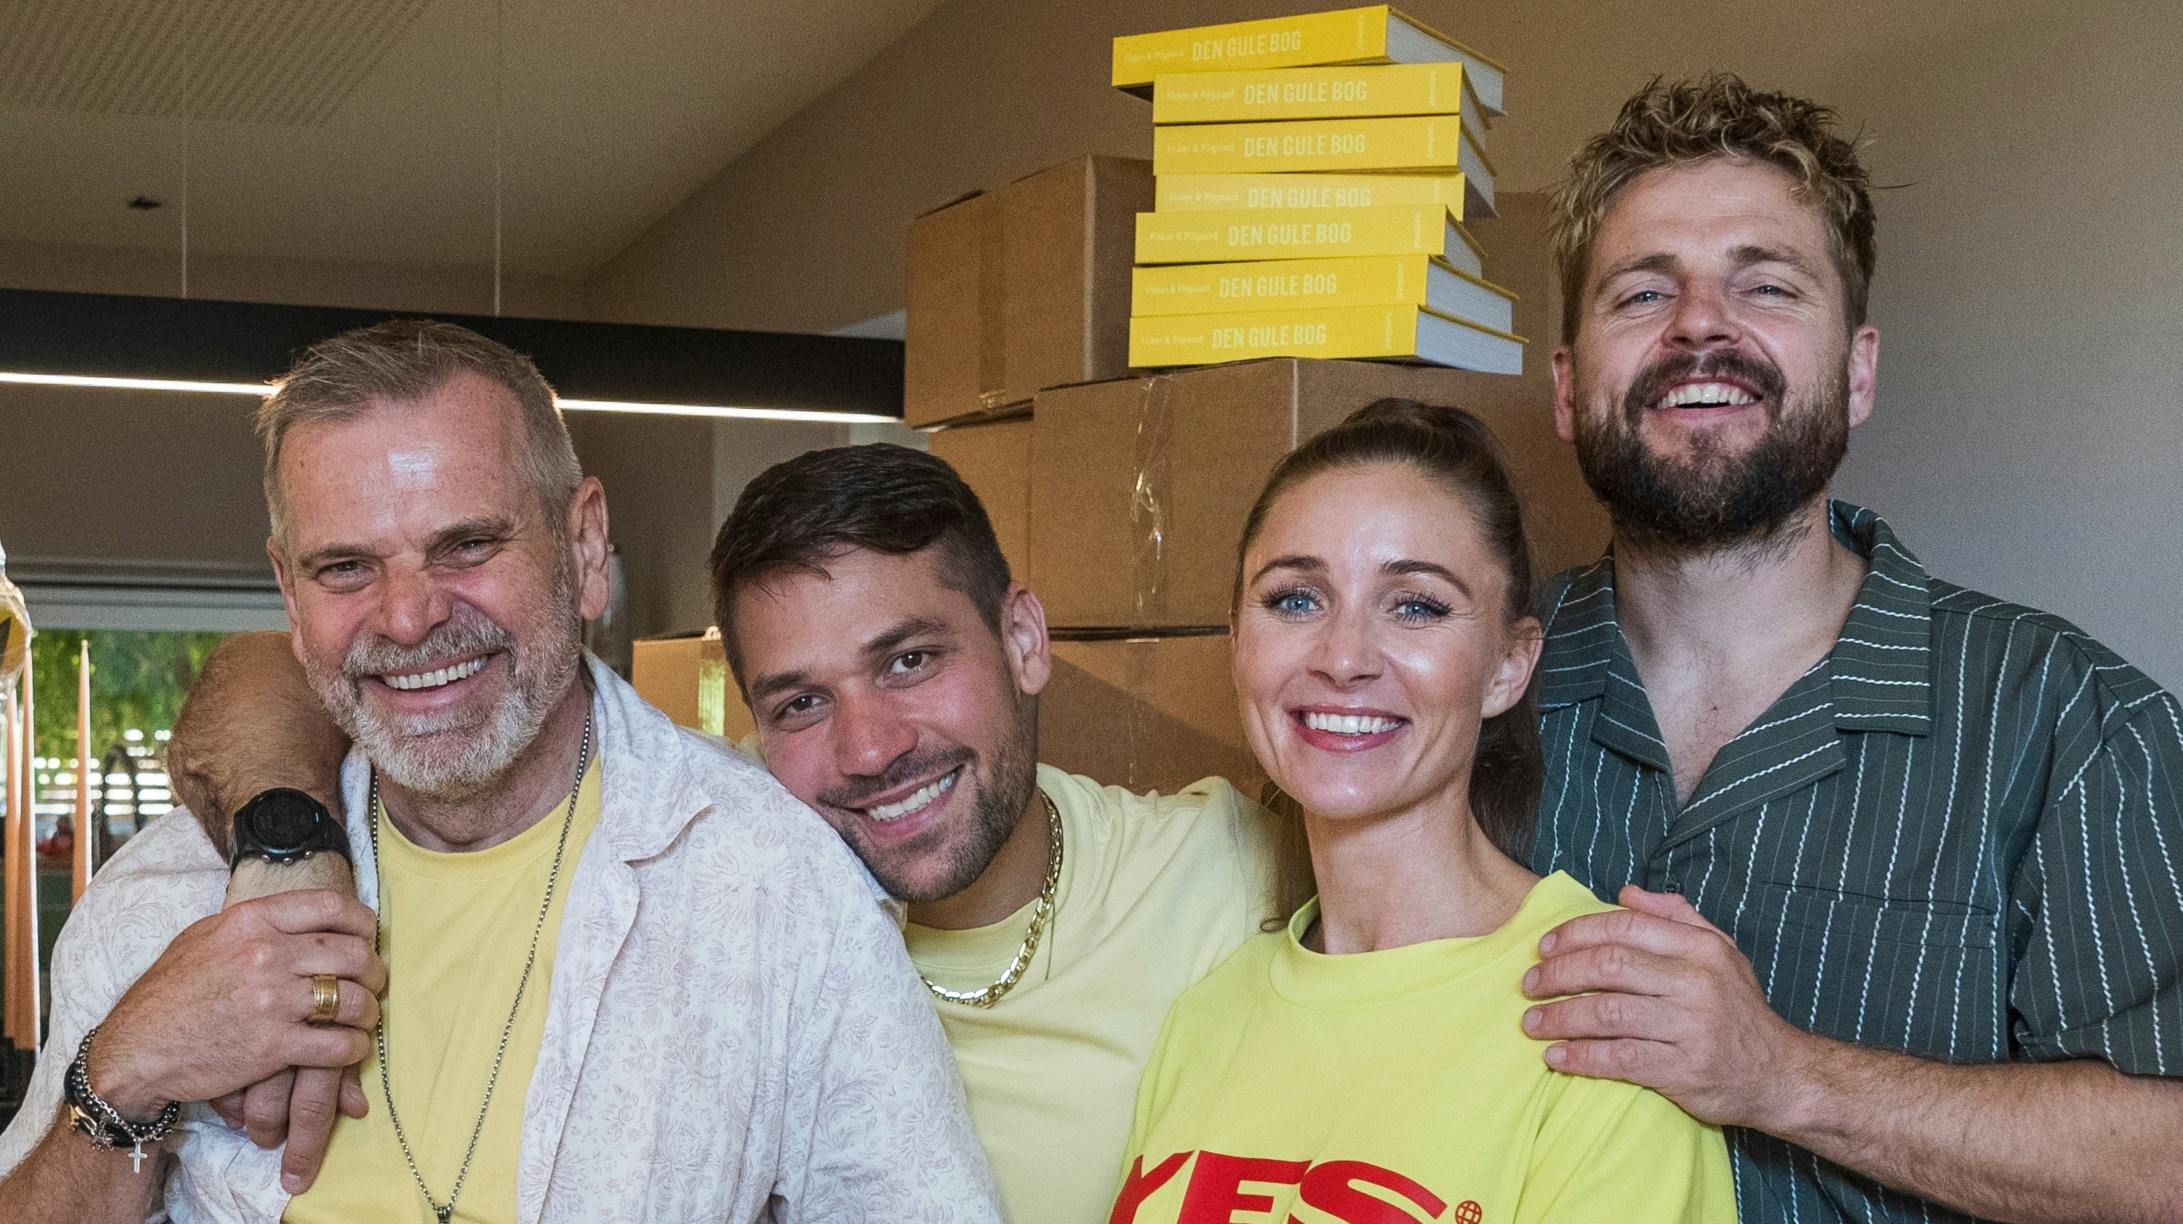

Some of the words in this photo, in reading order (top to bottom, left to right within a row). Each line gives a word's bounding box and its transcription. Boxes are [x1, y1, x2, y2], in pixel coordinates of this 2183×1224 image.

[1192, 40, 1222, 63] DEN
[1227, 34, 1265, 58] GULE
[1269, 31, 1301, 54] BOG
[1244, 83, 1279, 104] DEN
[1283, 81, 1327, 103] GULE
[1331, 80, 1367, 101] BOG
[1244, 136, 1279, 157] DEN
[1283, 134, 1326, 156] GULE
[1330, 133, 1366, 154] BOG
[1247, 187, 1283, 208] DEN
[1287, 186, 1330, 208] GULE
[1335, 186, 1371, 207] BOG
[1228, 225, 1263, 246] DEN
[1268, 224, 1312, 245] GULE
[1315, 223, 1352, 244] BOG
[1219, 277, 1252, 299] DEN
[1256, 275, 1297, 296] GULE
[1303, 273, 1337, 295] BOG
[1211, 327, 1245, 349] DEN
[1248, 325, 1289, 347] GULE
[1293, 323, 1327, 346] BOG
